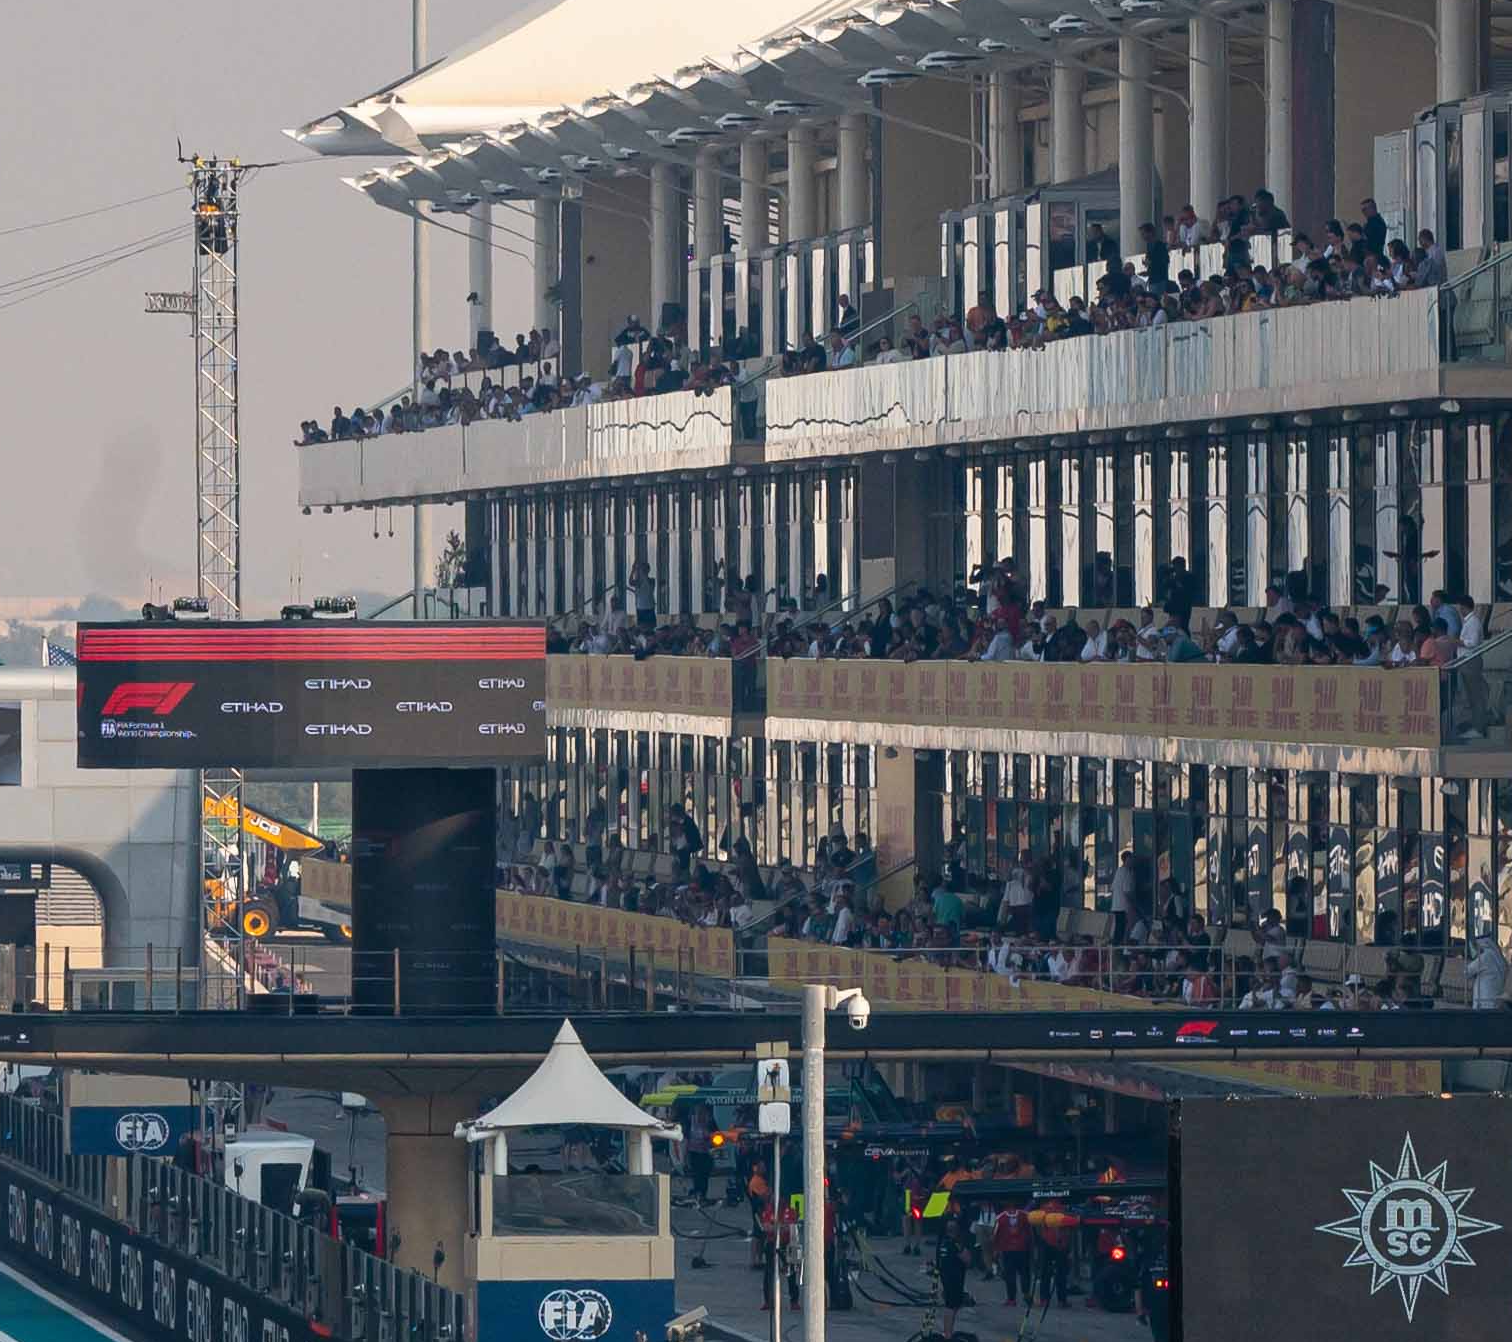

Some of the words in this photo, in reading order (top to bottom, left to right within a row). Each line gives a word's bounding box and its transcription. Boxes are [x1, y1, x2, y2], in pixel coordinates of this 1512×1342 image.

[305, 678, 372, 690] ETIHAD
[478, 677, 526, 690] ETIHAD
[220, 701, 284, 714] ETIHAD
[395, 701, 454, 713] ETIHAD
[304, 723, 373, 736] ETIHAD
[478, 722, 526, 735] ETIHAD
[250, 817, 281, 836] JCB
[118, 1118, 165, 1145] FIA
[542, 1295, 609, 1333] FIA
